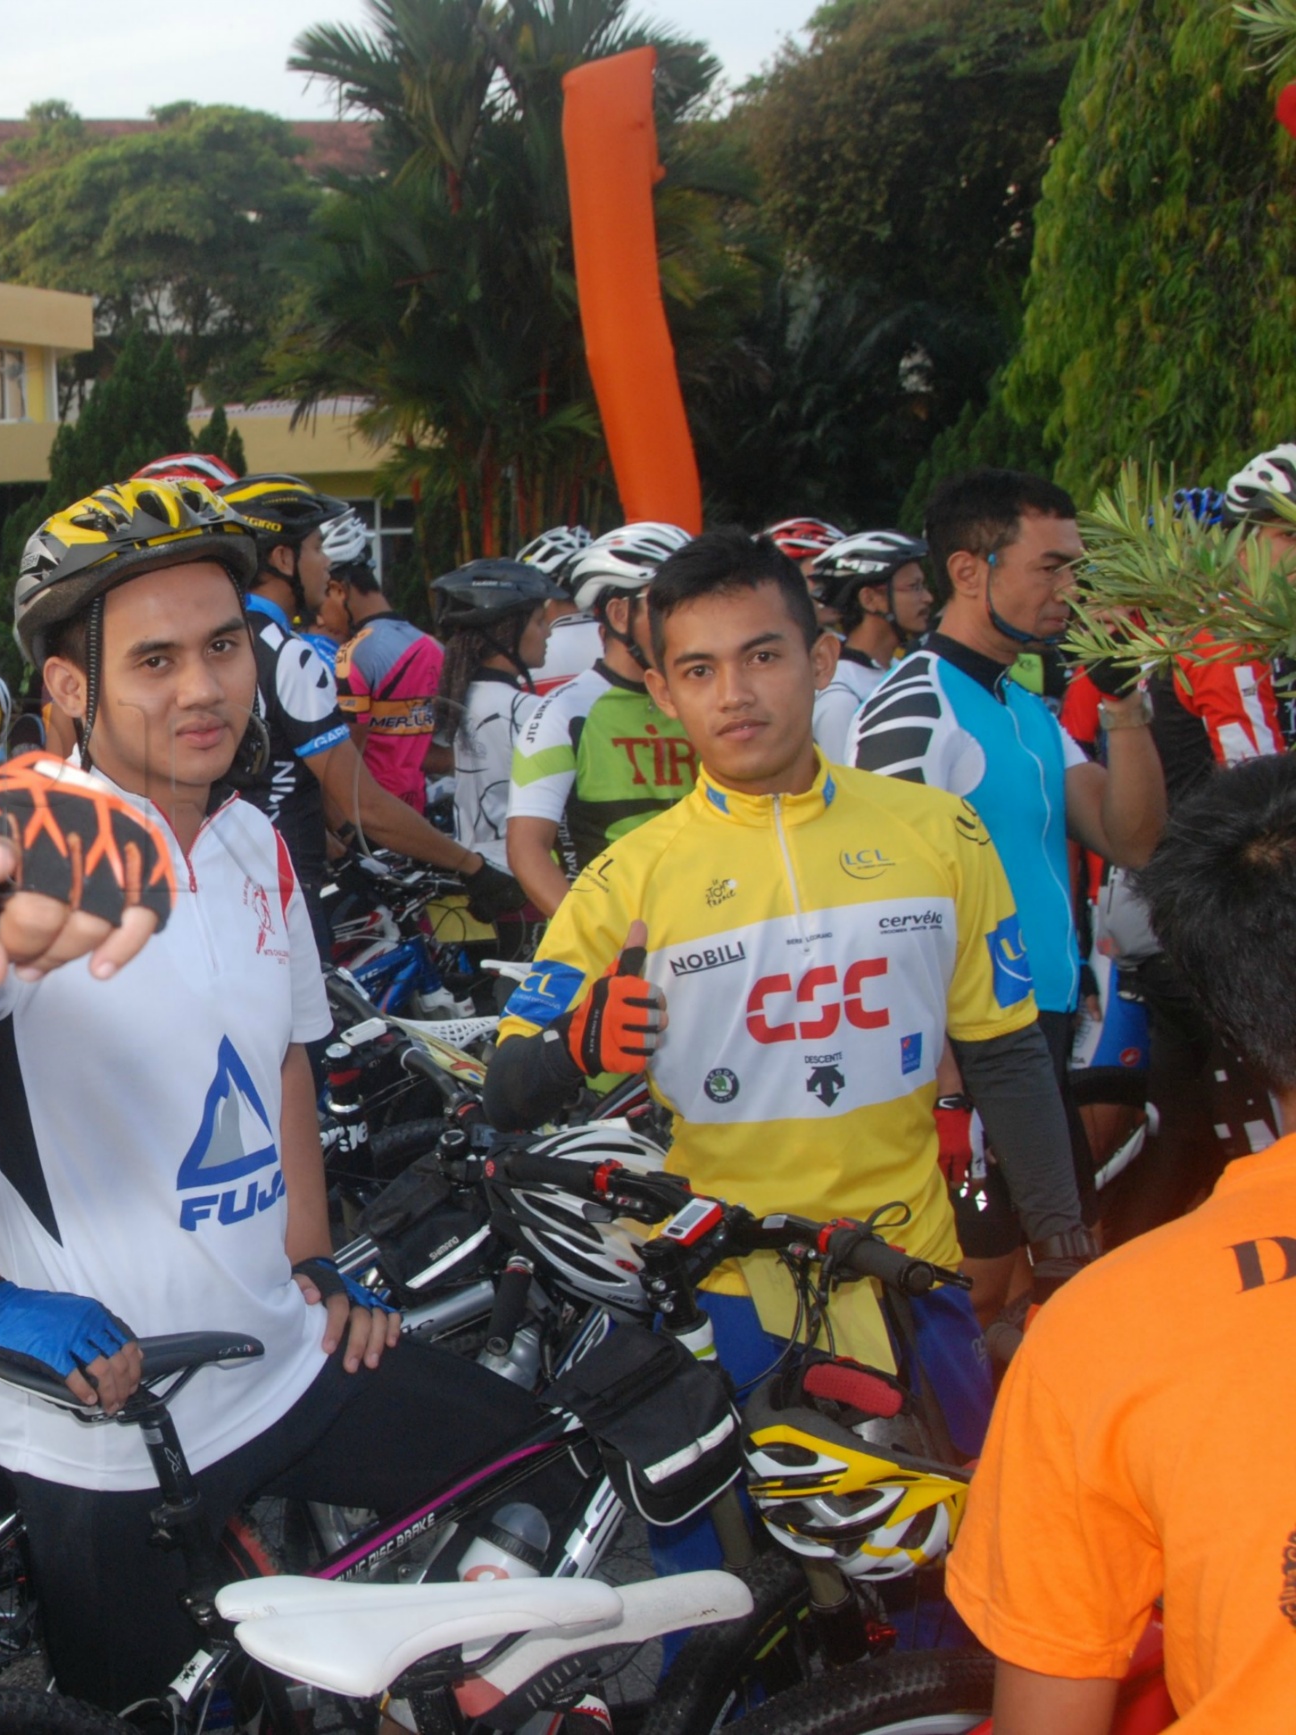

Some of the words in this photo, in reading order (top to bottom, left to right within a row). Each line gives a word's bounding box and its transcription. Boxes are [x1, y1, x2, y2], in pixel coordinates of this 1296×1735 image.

[835, 557, 892, 574] MET
[843, 849, 891, 866] LCL
[878, 910, 943, 929] cervélo
[670, 941, 746, 974] NOBILI
[519, 971, 556, 998] CL
[746, 957, 890, 1044] CSC
[805, 1051, 843, 1065] DESCENTE
[429, 1235, 460, 1261] SHIMANO
[368, 1540, 395, 1567] DISC
[396, 1512, 436, 1548] BRAKE
